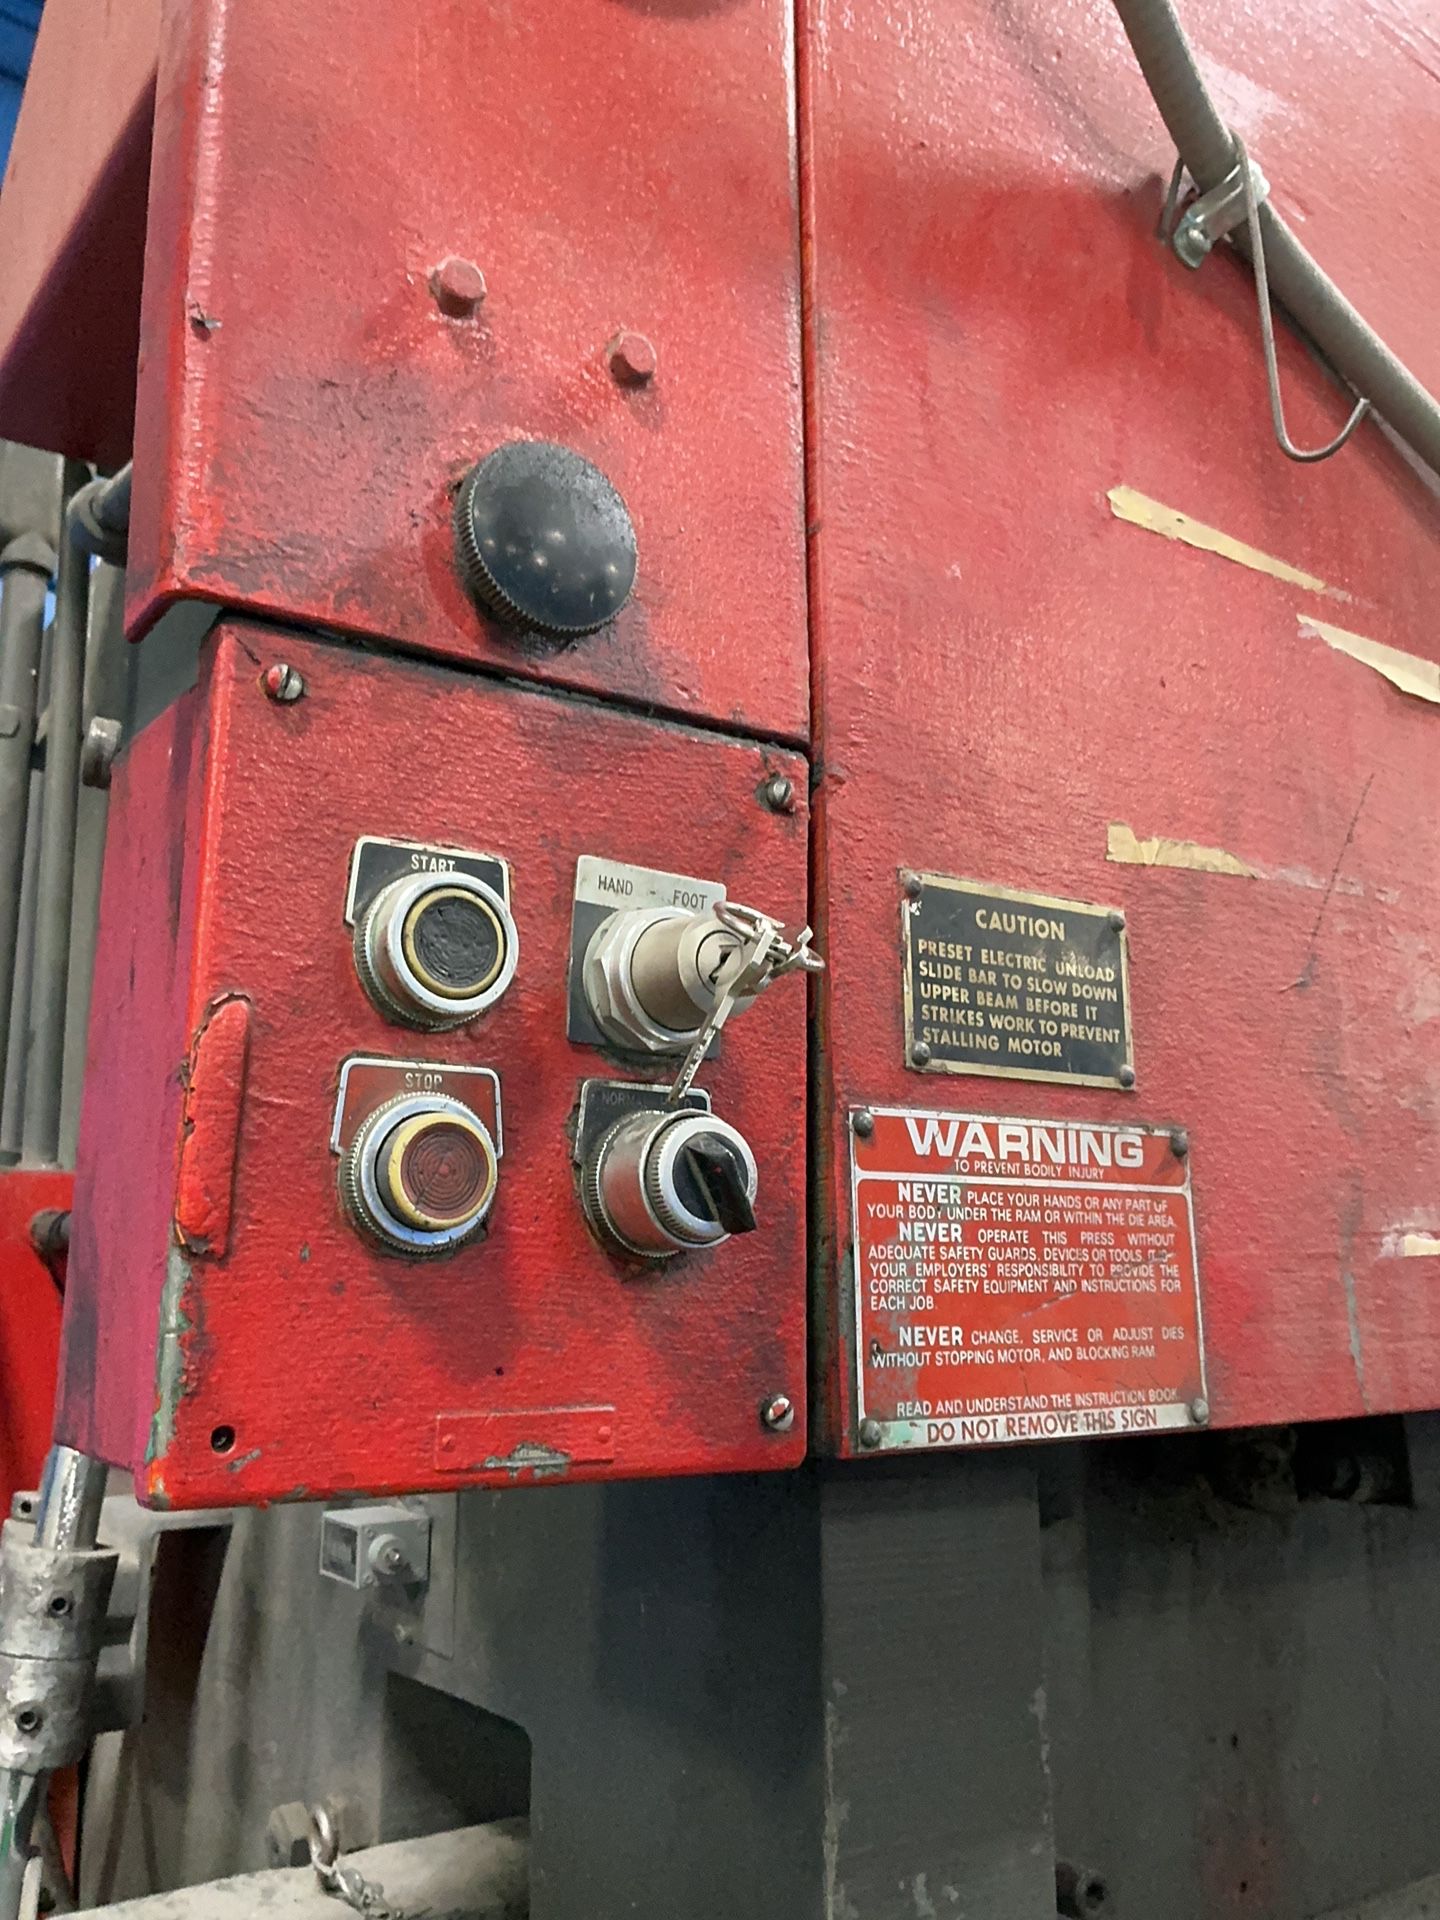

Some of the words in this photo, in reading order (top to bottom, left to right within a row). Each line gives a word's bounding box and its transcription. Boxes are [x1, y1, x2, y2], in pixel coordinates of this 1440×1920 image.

[411, 854, 456, 872] START
[597, 875, 633, 895] HAND
[673, 889, 708, 909] FOOT
[975, 909, 1065, 941] CAUTION
[918, 939, 972, 962] PRESET
[981, 949, 1046, 972] ELECTRIC
[1055, 961, 1115, 982] UNLOAD
[919, 961, 962, 981] SLIDE
[968, 968, 997, 986] BAR
[1002, 973, 1021, 990] TO
[1027, 977, 1067, 996] SLOW
[1072, 984, 1117, 1002] DOWN
[920, 983, 969, 1004] UPPER
[976, 990, 1019, 1010] BEAM
[1026, 997, 1078, 1018] BEFORE
[1085, 1005, 1097, 1021] IT
[921, 1005, 984, 1027] STRIKES
[989, 1013, 1035, 1034] WORK
[1039, 1019, 1058, 1036] TO
[1061, 1024, 1120, 1044] PREVENT
[922, 1027, 999, 1051] STALLING
[1008, 1037, 1062, 1057] MOTOR
[405, 1072, 443, 1089] STOP
[905, 1117, 1144, 1168] WARNING
[954, 1159, 969, 1173] TO
[974, 1160, 1020, 1175] PREVENT
[1024, 1164, 1062, 1178] BODILY
[1069, 1167, 1105, 1179] INJURY
[898, 1182, 961, 1204] NEVER
[967, 1191, 1003, 1205] PLACE
[1007, 1192, 1040, 1207] YOUR
[1044, 1194, 1081, 1208] HANDS
[1084, 1196, 1099, 1209] OR
[1102, 1197, 1123, 1211] ANY
[1126, 1198, 1150, 1212] PART
[1153, 1199, 1168, 1213] OF
[868, 1203, 904, 1219] YOUR
[909, 1205, 942, 1219] BODY
[947, 1207, 987, 1221] UNDER
[991, 1208, 1011, 1222] THE
[1016, 1208, 1040, 1223] RAM
[1044, 1210, 1059, 1223] OR
[1063, 1211, 1102, 1225] WITHIN
[1105, 1213, 1125, 1226] THE
[1129, 1214, 1144, 1227] DIE
[899, 1222, 963, 1243] NEVER
[978, 1229, 1029, 1244] OPERATE
[1042, 1230, 1067, 1245] THIS
[1080, 1231, 1115, 1245] PRESS
[1127, 1232, 1175, 1246] WITHOUT
[868, 1245, 935, 1261] ADEQUATE
[939, 1246, 984, 1261] SAFETY
[1044, 1248, 1089, 1261] DEVICES
[1091, 1249, 1106, 1262] OR
[870, 1262, 907, 1277] YOUR
[997, 1264, 1084, 1278] RESPONSIBILITY
[1089, 1264, 1104, 1277] TO
[1110, 1264, 1155, 1277] PROVIDE
[1160, 1265, 1180, 1277] THE
[870, 1279, 927, 1294] CORRECT
[933, 1279, 979, 1294] SAFETY
[983, 1279, 1048, 1294] EQUIPMENT
[1053, 1279, 1077, 1293] AND
[1081, 1279, 1156, 1292] INSTRUCTIONS
[1160, 1279, 1181, 1292] FOR
[871, 1296, 906, 1311] EACH
[899, 1326, 963, 1347] NEVER
[1032, 1328, 1078, 1344] SERVICE
[1087, 1328, 1103, 1342] OR
[1113, 1327, 1153, 1341] ADJUST
[1161, 1326, 1184, 1340] DIES
[872, 1352, 931, 1368] WITHOUT
[935, 1350, 994, 1366] STOPPING
[1048, 1348, 1072, 1361] AND
[1076, 1346, 1129, 1361] BLOCKING
[896, 1400, 932, 1417] READ
[935, 1399, 963, 1415] AND
[966, 1394, 1048, 1413] UNDERSTAND
[1050, 1393, 1072, 1408] THE
[1075, 1390, 1144, 1406] INSTRUCTION
[927, 1421, 955, 1443] DO
[961, 1418, 998, 1441] NOT
[1006, 1413, 1078, 1437] REMOVE
[1083, 1410, 1116, 1431] THIS
[1121, 1408, 1157, 1429] SIGN
